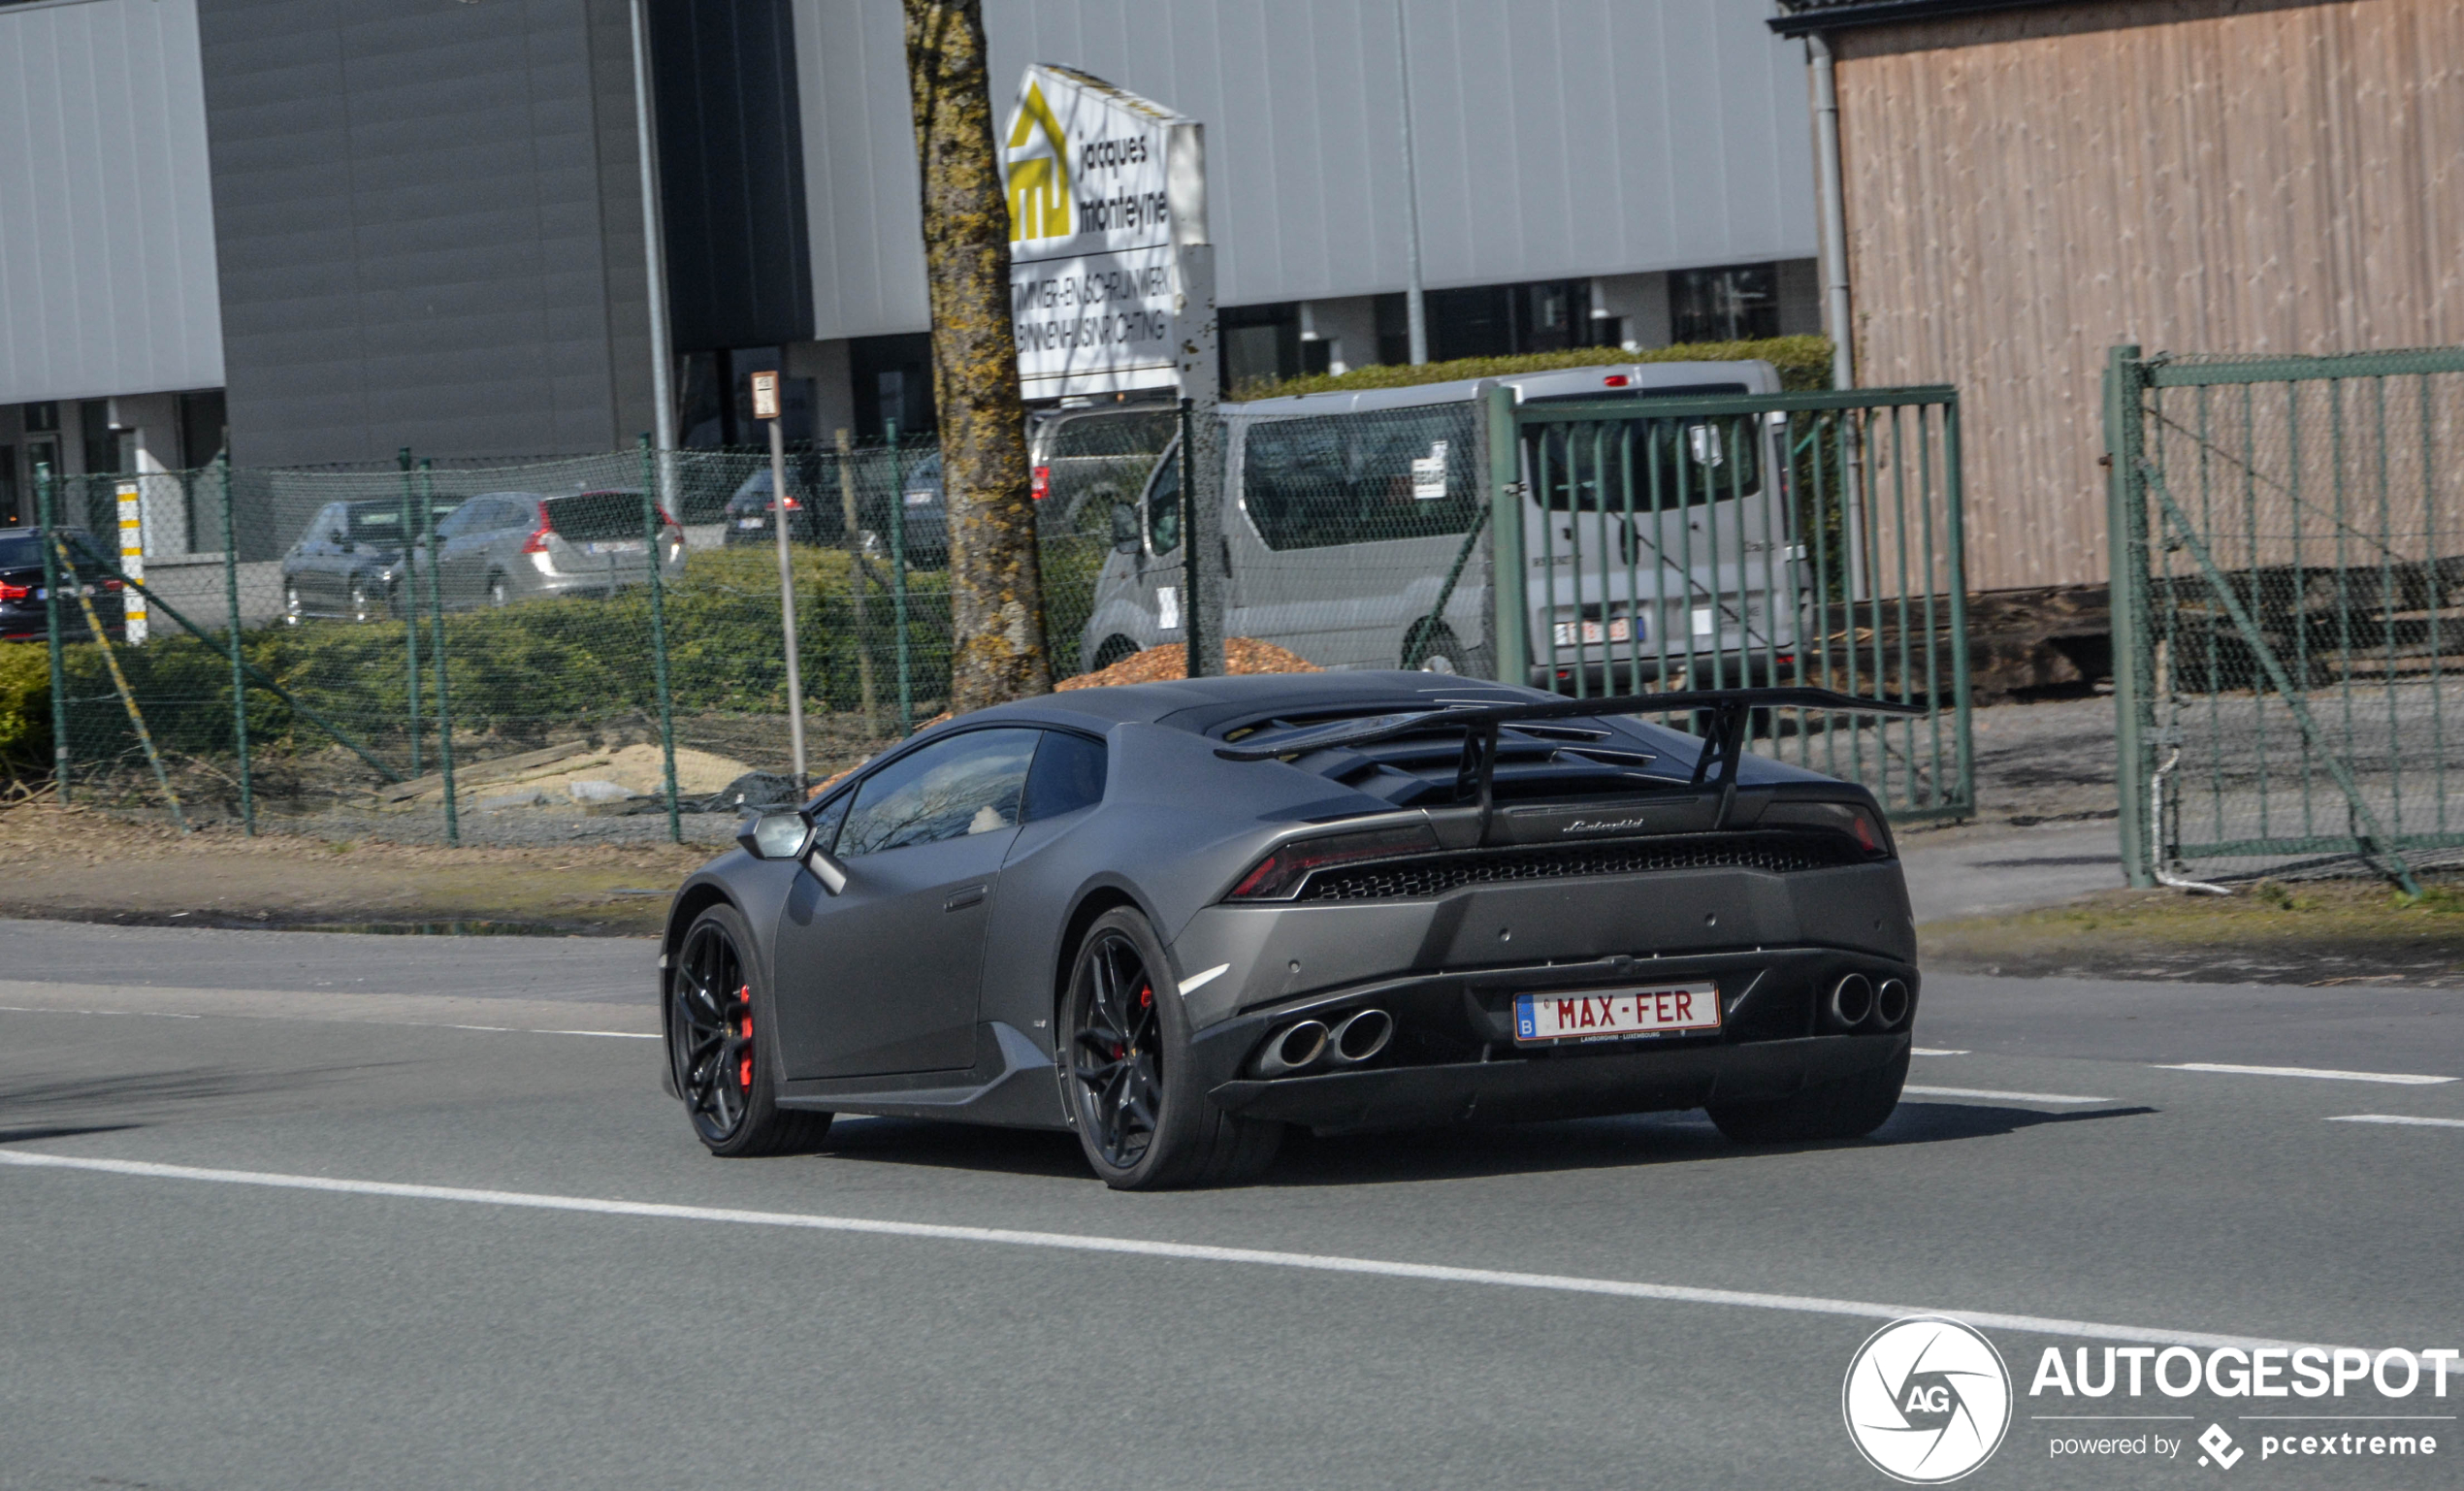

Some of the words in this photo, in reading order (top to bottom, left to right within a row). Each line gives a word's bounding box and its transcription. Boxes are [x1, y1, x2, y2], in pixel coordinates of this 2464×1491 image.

[1079, 130, 1148, 182] jacques
[1079, 185, 1168, 235] monteyne
[1521, 1020, 1534, 1035] B
[1557, 990, 1694, 1030] MAX-FER
[1580, 1033, 1619, 1043] LAMBORGHINI
[1623, 1031, 1661, 1040] LUXEMBOURG
